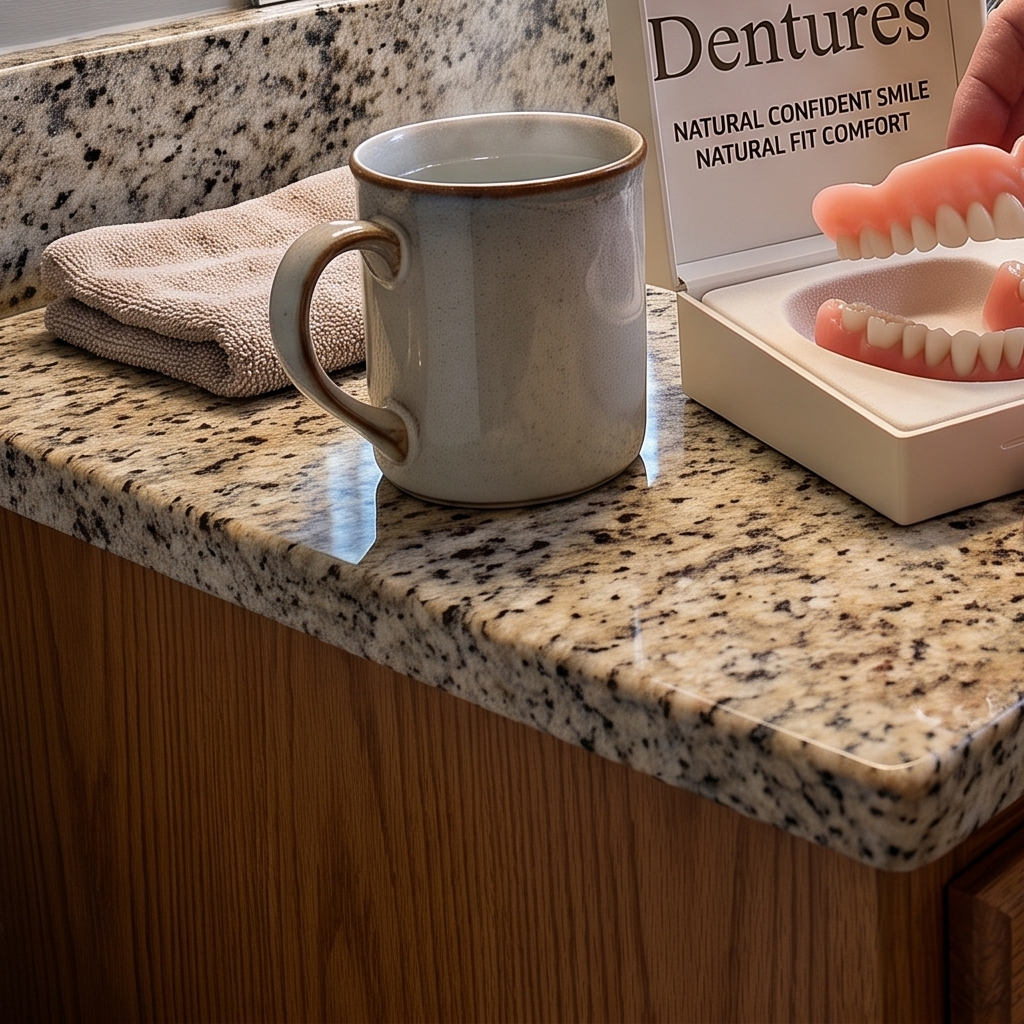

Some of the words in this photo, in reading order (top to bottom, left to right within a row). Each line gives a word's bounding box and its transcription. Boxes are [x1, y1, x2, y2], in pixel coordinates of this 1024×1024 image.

[673, 110, 764, 142] NATURAL
[768, 90, 872, 126] CONFIDENT
[877, 80, 930, 107] SMILE
[696, 136, 786, 169] NATURAL
[790, 129, 817, 151] FIT
[822, 112, 911, 144] COMFORT
